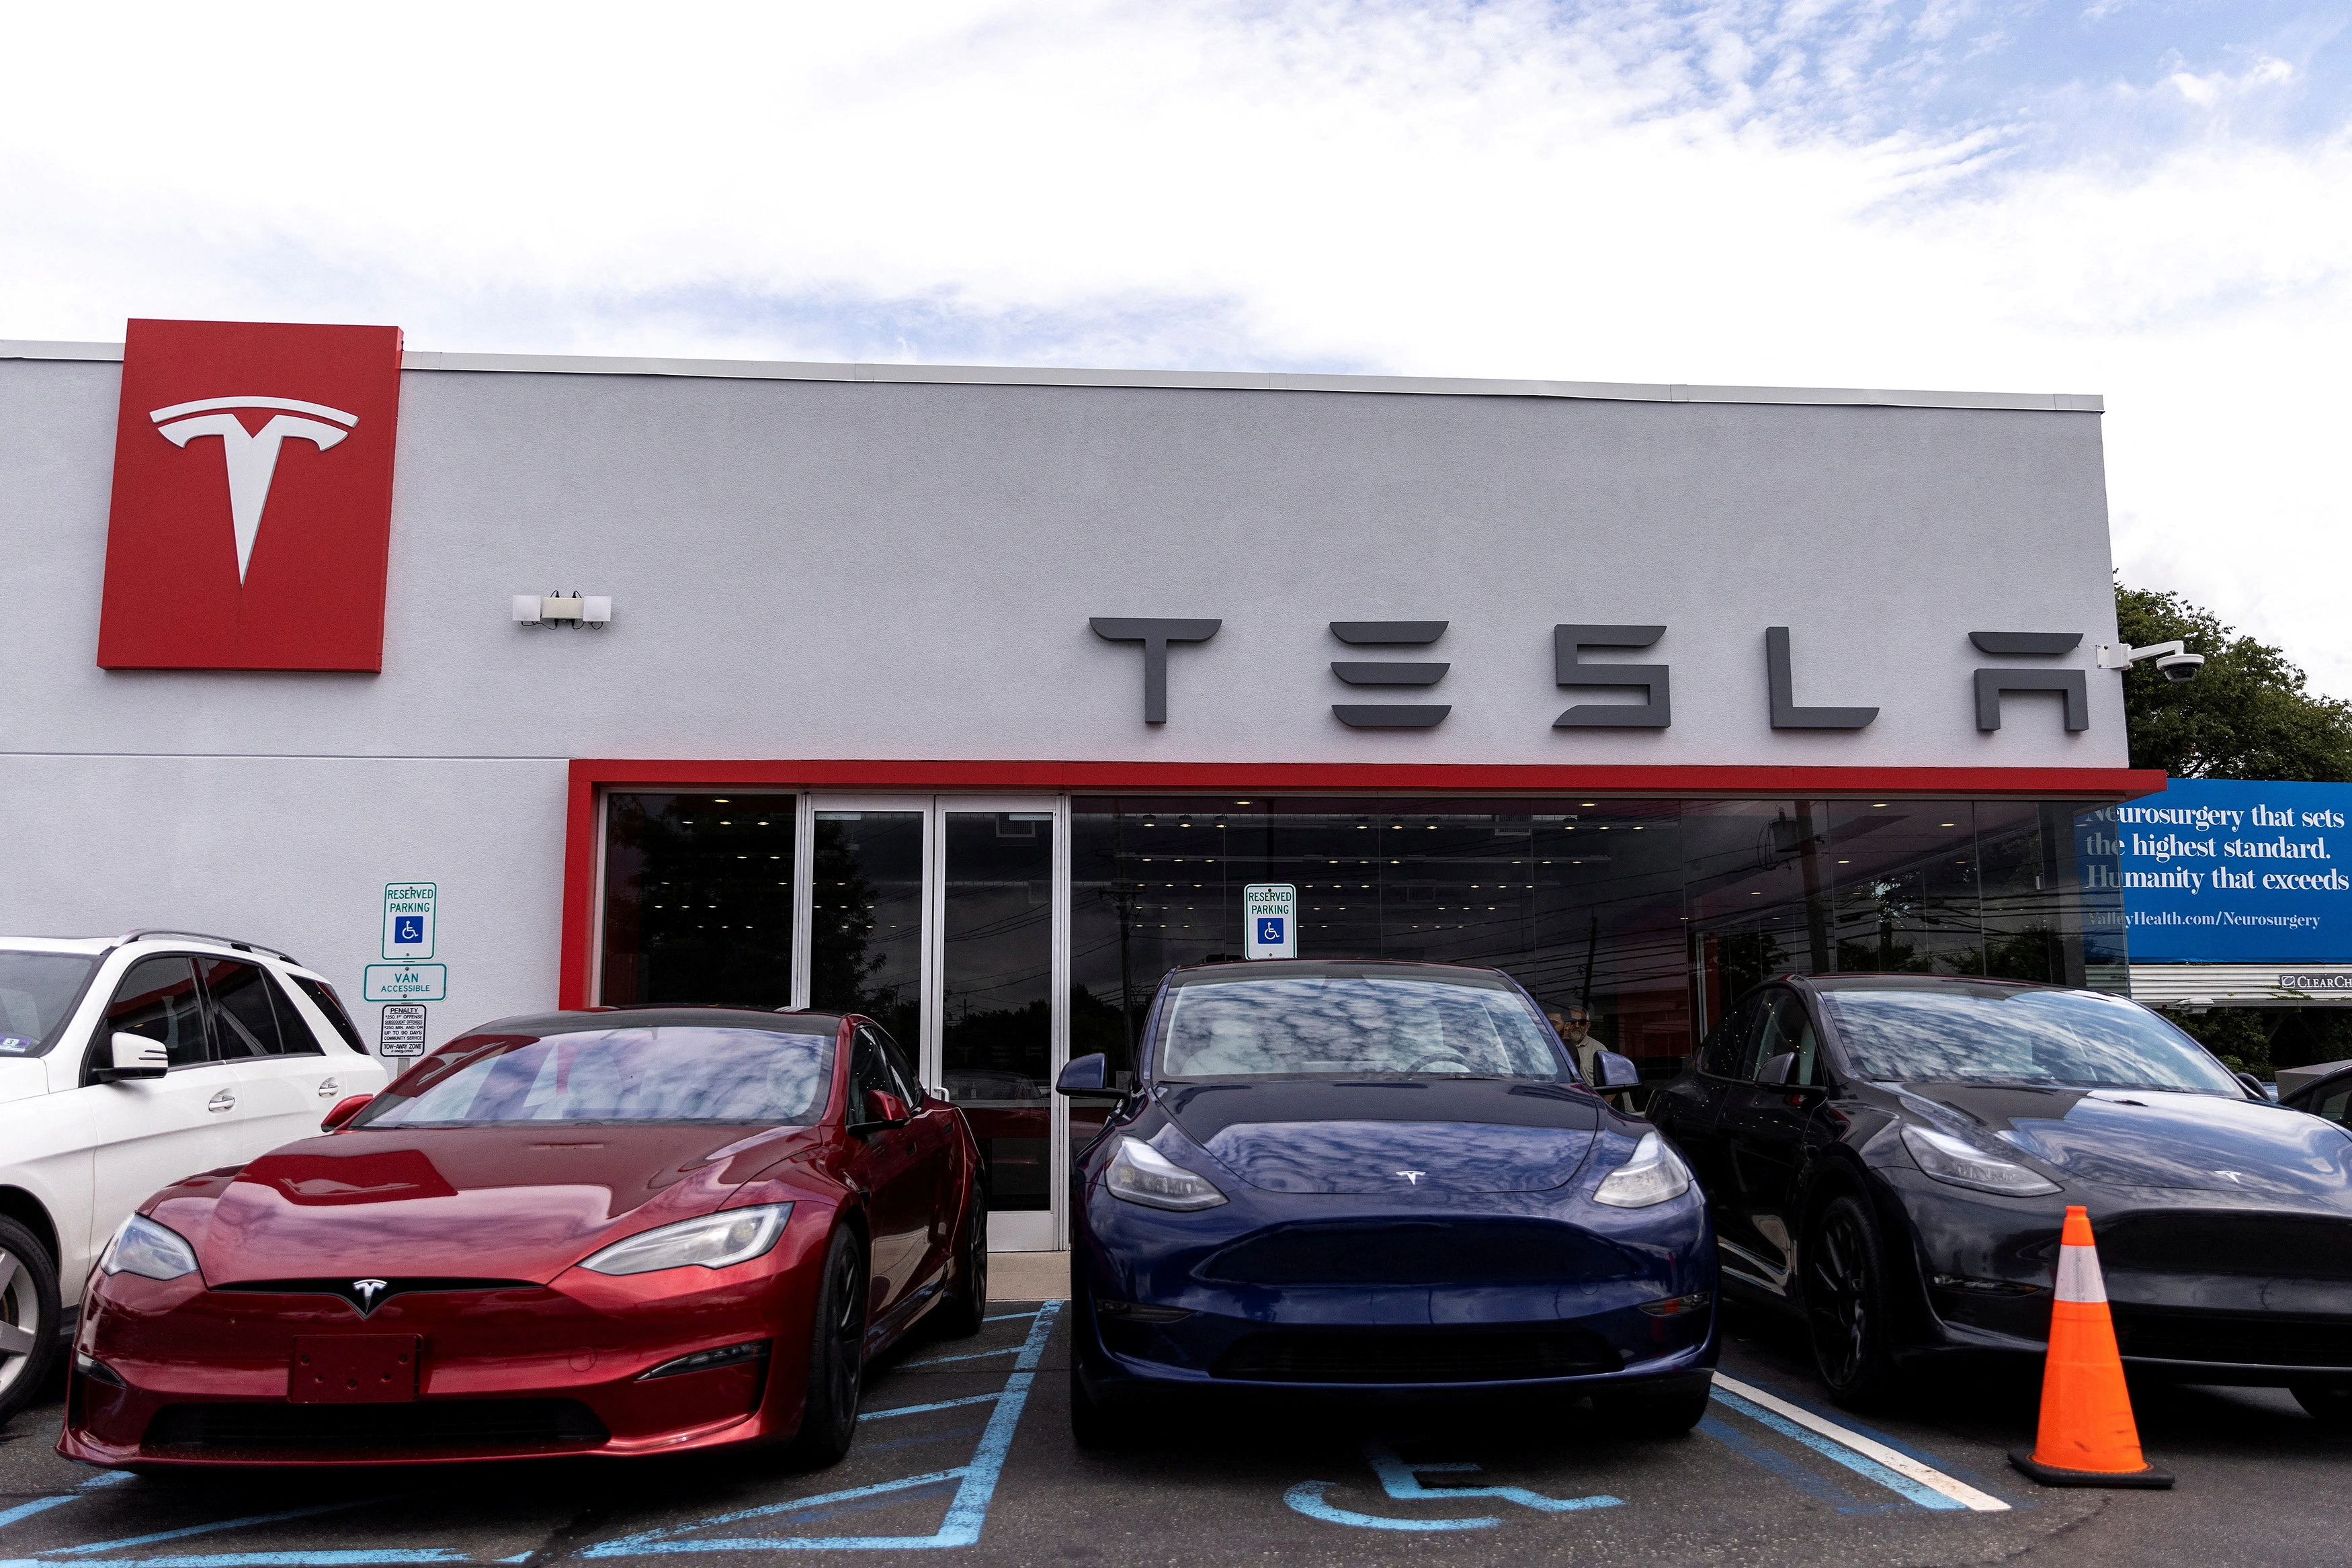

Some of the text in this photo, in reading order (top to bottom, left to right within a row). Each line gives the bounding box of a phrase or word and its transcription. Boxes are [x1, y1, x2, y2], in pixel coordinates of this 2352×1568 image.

[1089, 616, 2089, 731] TESLA
[2085, 804, 2345, 832] Neurosurgery that sets
[2085, 832, 2330, 863] the highest standard.
[2086, 865, 2349, 894] Humanity that exceeds
[388, 889, 433, 900] RESERVED
[1249, 892, 1292, 901] RESERVED
[390, 903, 430, 912] PARKING
[1252, 905, 1289, 914] PARKING
[394, 973, 419, 983] VAN
